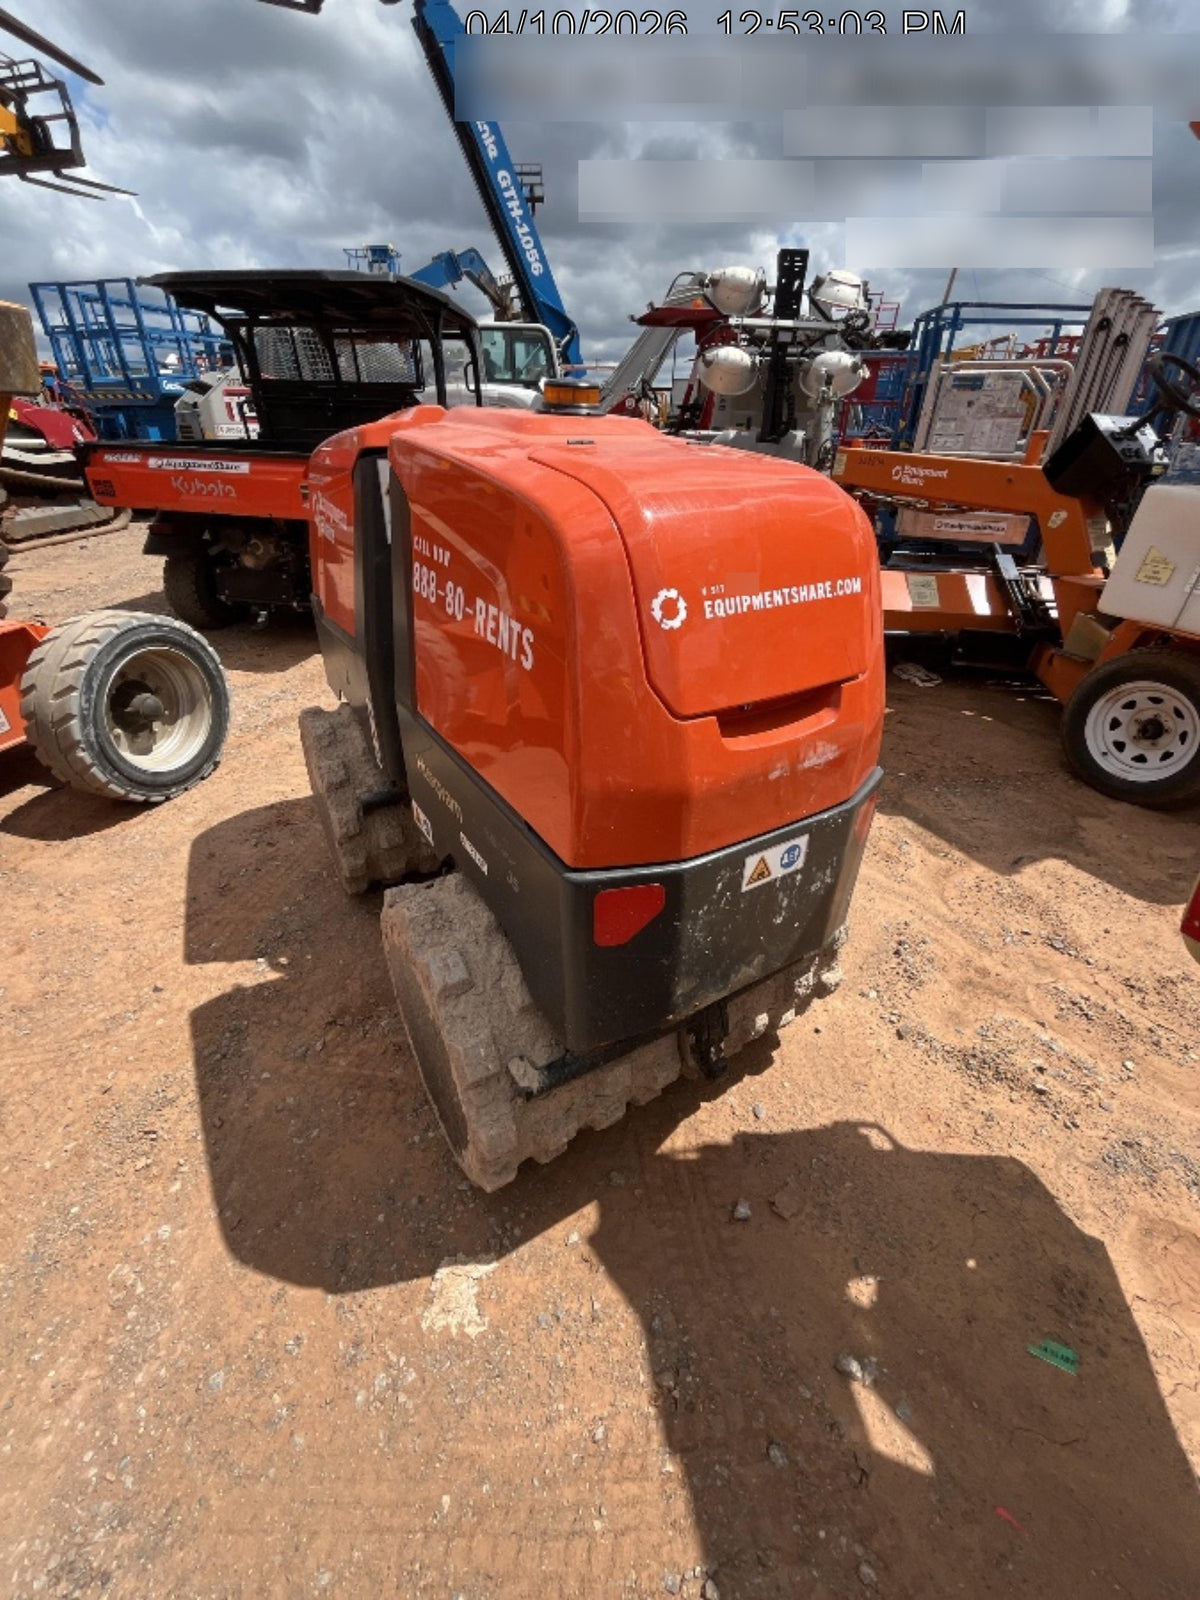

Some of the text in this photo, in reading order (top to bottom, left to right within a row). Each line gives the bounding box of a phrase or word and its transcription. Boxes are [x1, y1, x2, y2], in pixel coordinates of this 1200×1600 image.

[497, 169, 543, 276] GTH-1056
[170, 475, 236, 498] Kubota
[413, 561, 535, 671] 888-80-RENTS
[704, 577, 862, 619] EQUIPMENTSHARE.COM
